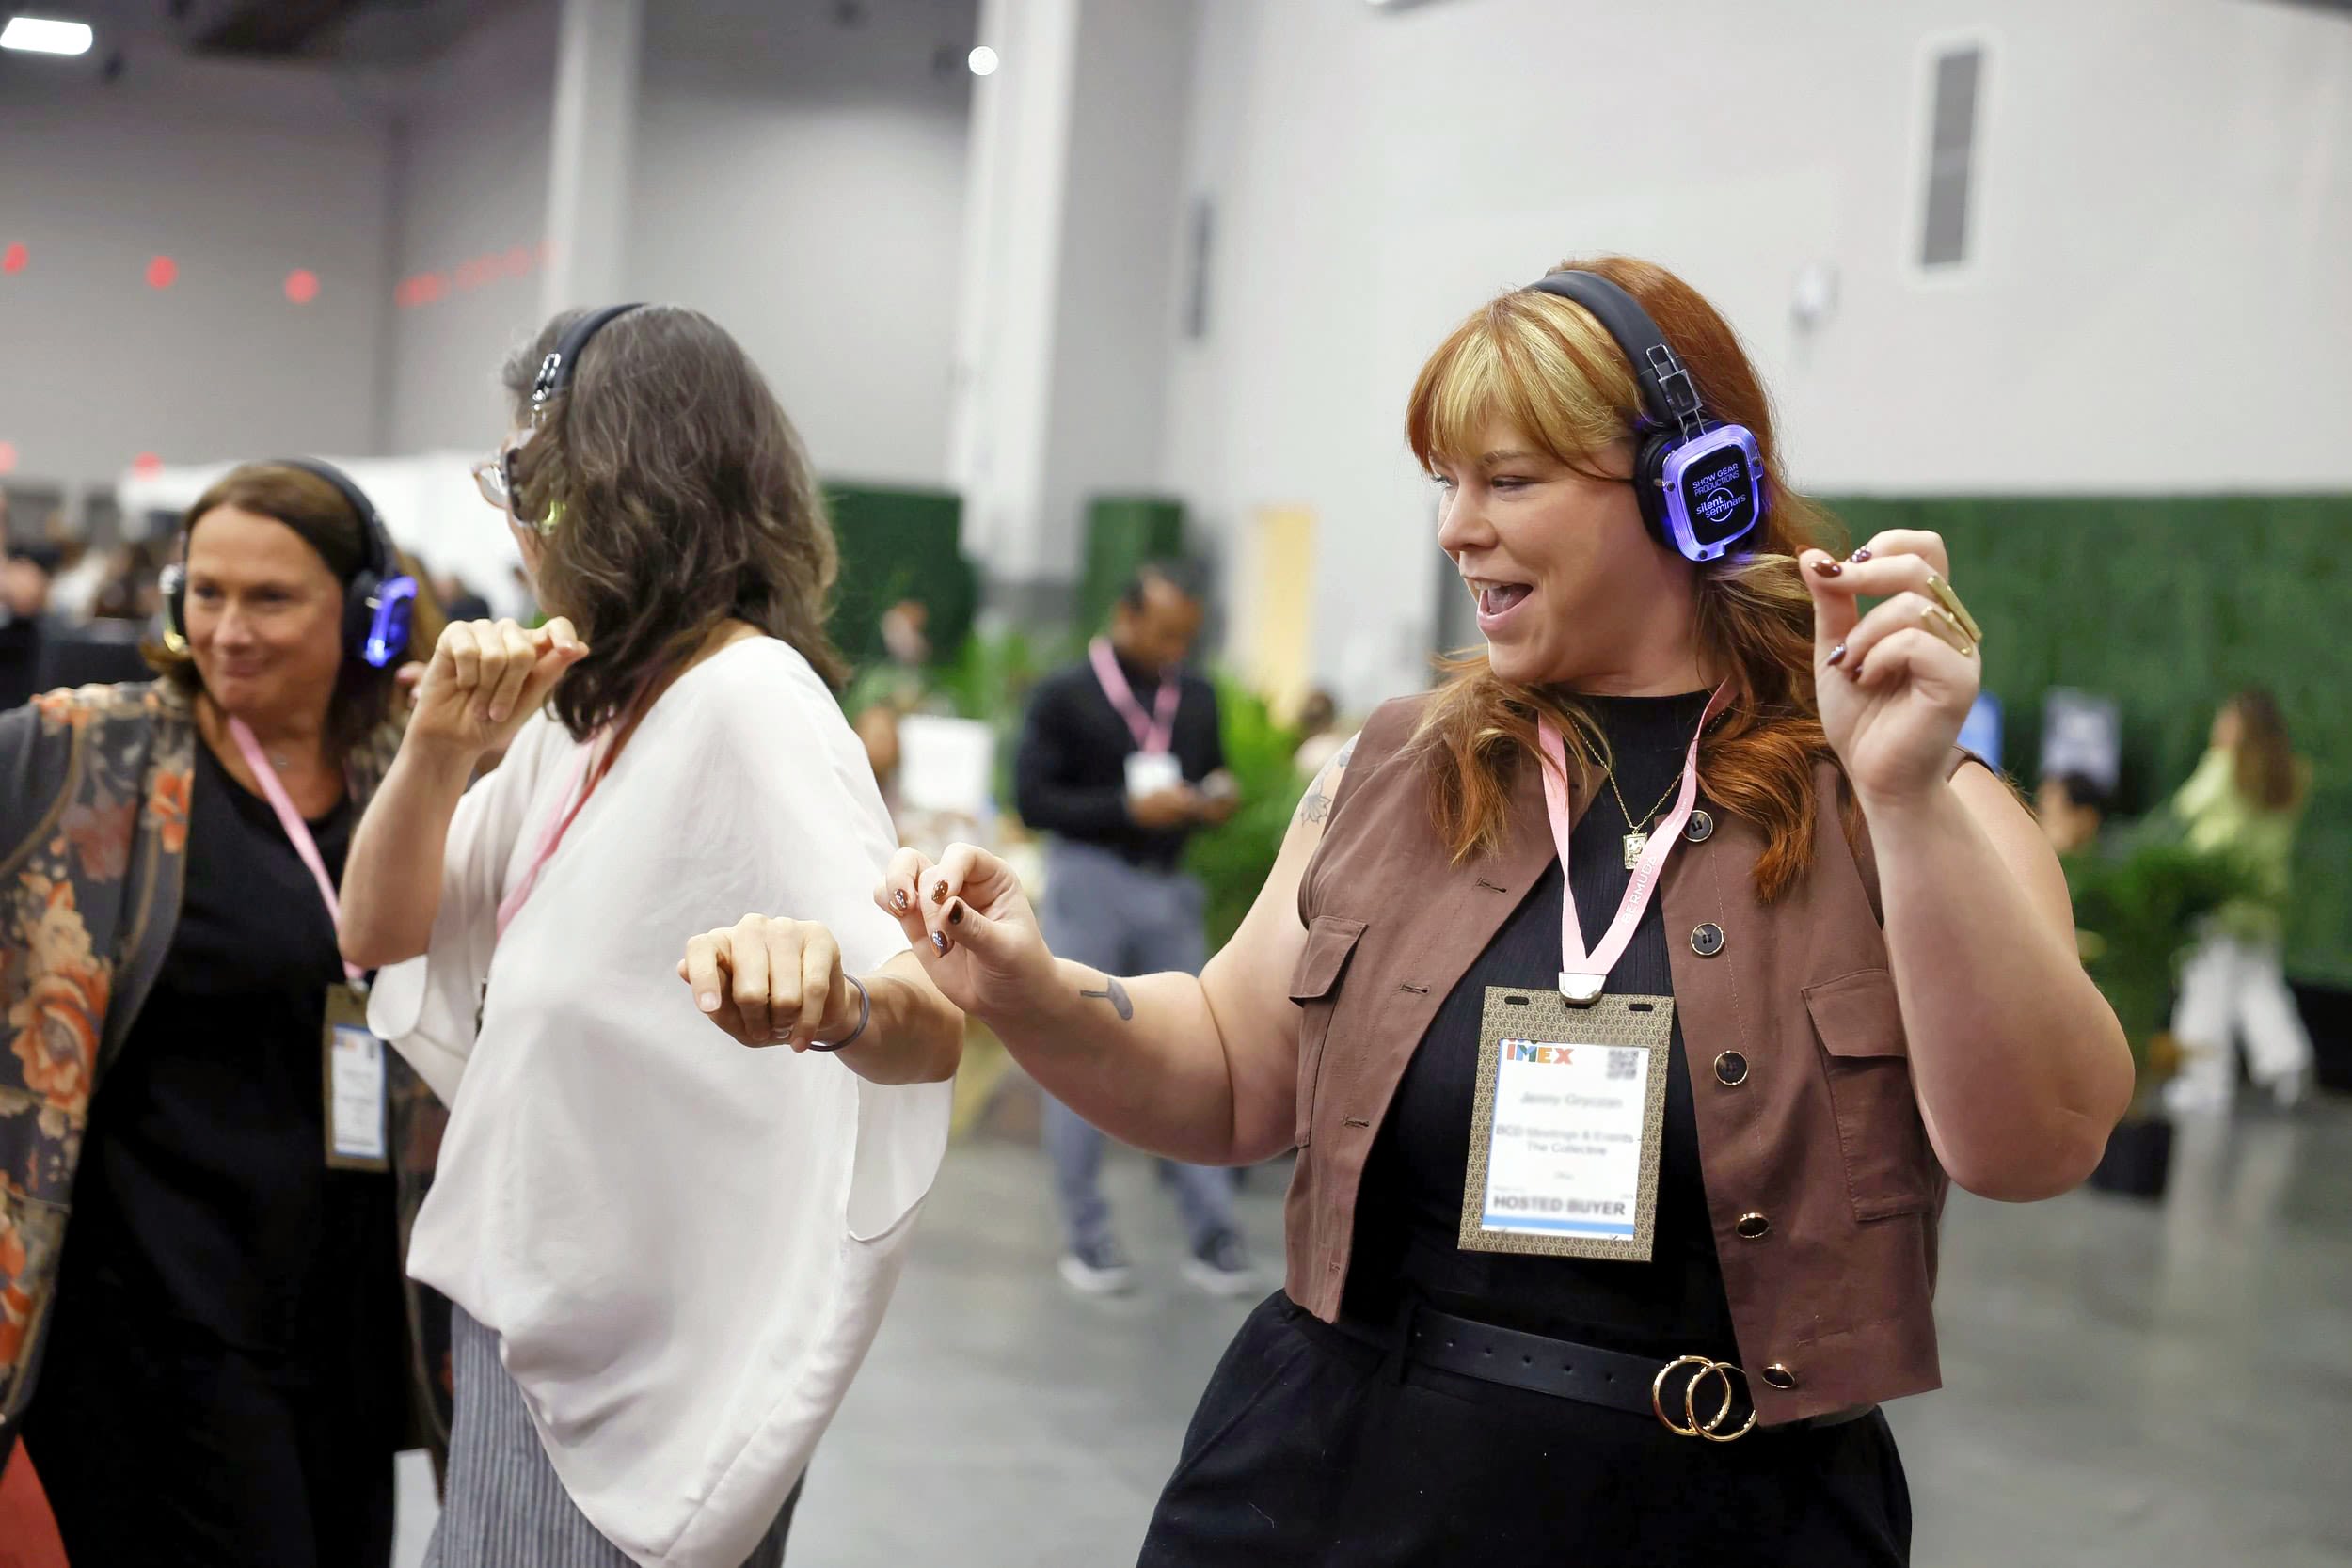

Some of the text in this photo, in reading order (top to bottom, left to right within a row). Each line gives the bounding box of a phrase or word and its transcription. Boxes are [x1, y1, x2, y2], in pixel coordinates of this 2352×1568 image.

[1692, 463, 1739, 490] SHOW GEAR
[1694, 470, 1740, 497] PRODUCTIONS
[1696, 495, 1724, 515] silent
[1705, 494, 1747, 518] seminars
[1621, 857, 1657, 924] BERMUDA
[1506, 1043, 1575, 1065] IMEX
[1493, 1195, 1626, 1216] HOSTED BUYER
